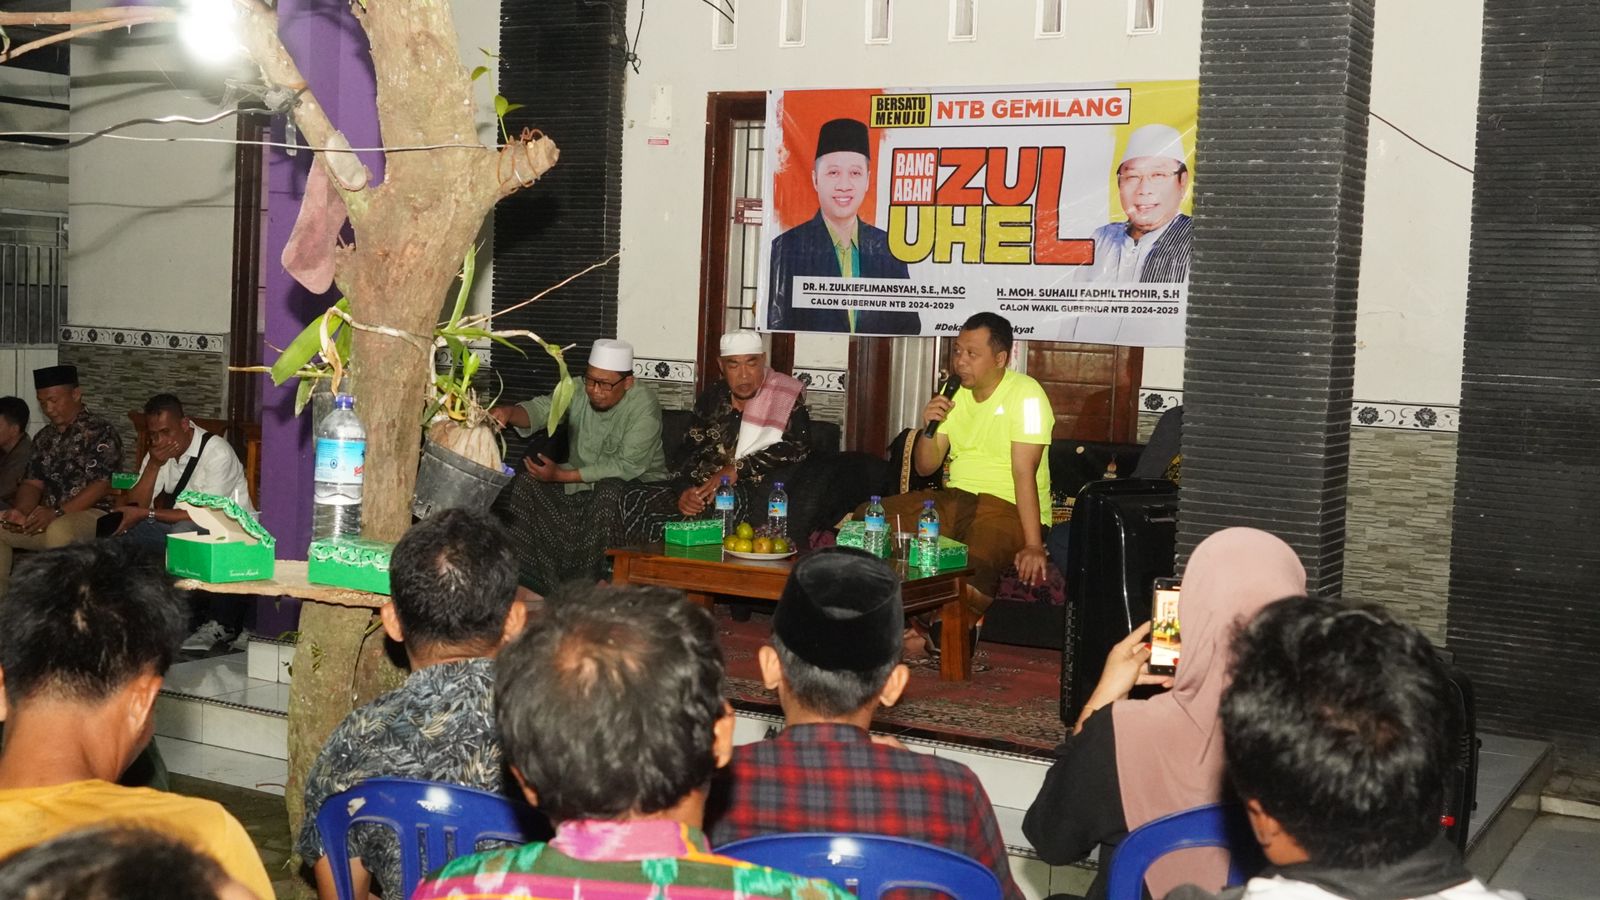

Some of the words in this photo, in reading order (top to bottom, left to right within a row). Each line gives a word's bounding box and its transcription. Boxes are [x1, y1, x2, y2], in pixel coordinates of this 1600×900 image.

[876, 97, 926, 110] BERSATU
[937, 100, 985, 120] NTB
[991, 97, 1123, 118] GEMILANG
[876, 111, 925, 126] MENUJU
[895, 152, 934, 177] BANG
[893, 178, 932, 202] ABAH
[802, 282, 817, 291] DR.
[818, 283, 828, 292] H.
[830, 284, 920, 295] ZULKIEFLIMANSYAH,
[920, 286, 940, 296] S.E.,
[941, 286, 966, 295] M.SC
[996, 288, 1006, 296] H.
[1008, 288, 1036, 297] MOH.
[1038, 288, 1078, 298] SUHAILI
[1080, 289, 1116, 298] FADHIL
[1118, 289, 1161, 300] THOHIR,
[1162, 290, 1180, 299] S.H
[810, 298, 839, 306] CALON
[841, 299, 888, 308] GUBERNUR
[908, 301, 955, 310] 2024-2029
[1000, 304, 1029, 312] CALON
[1032, 304, 1059, 312] WAKIL
[1060, 305, 1109, 313] GUBERNUR
[1110, 306, 1129, 314] NTB
[1130, 306, 1179, 314] 2024-2029
[934, 323, 964, 332] #Deka
